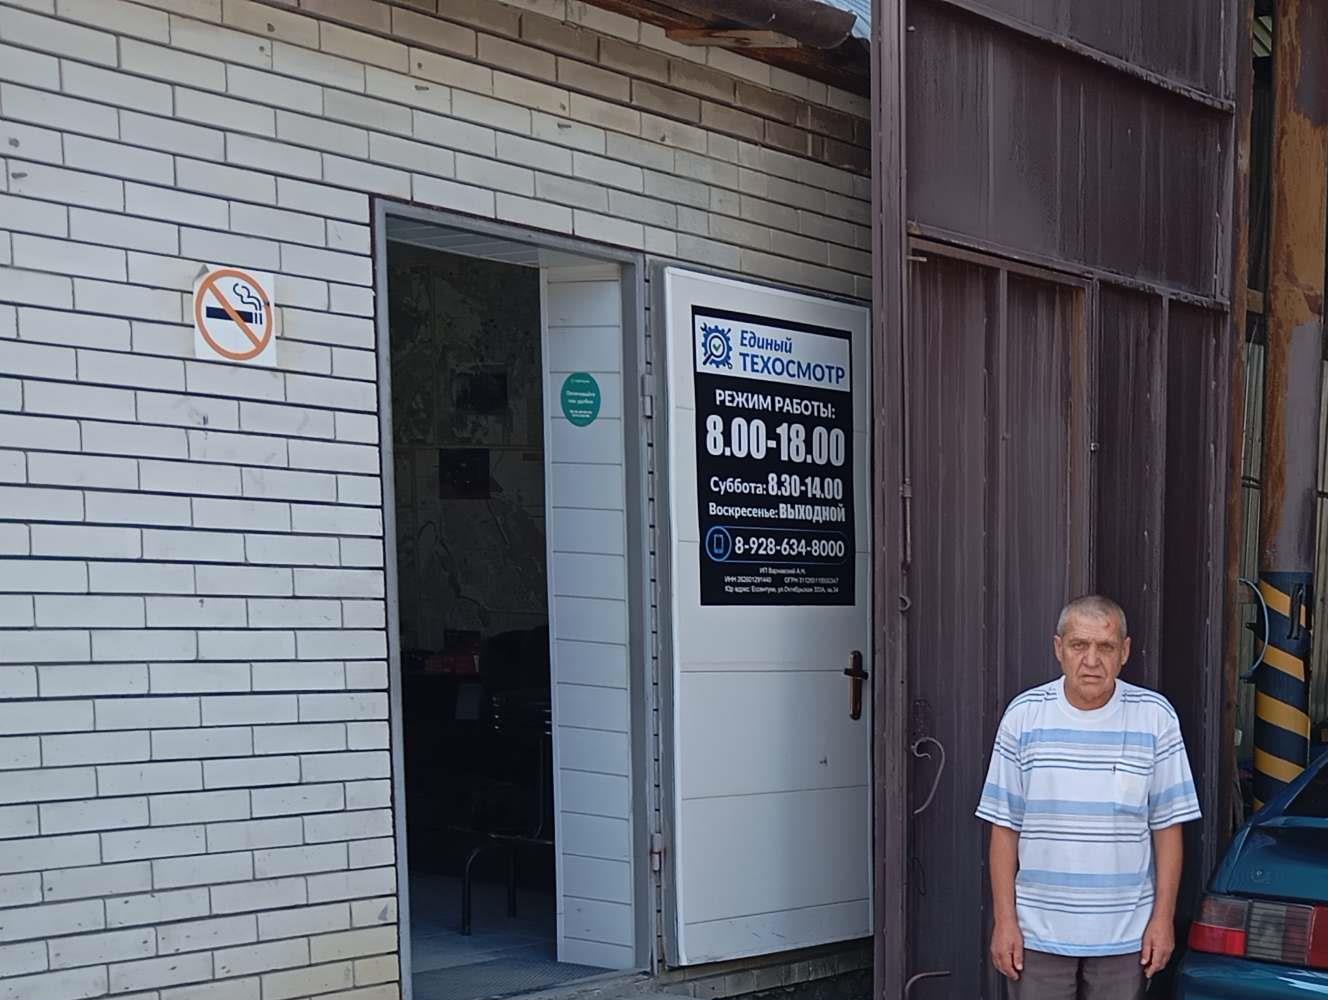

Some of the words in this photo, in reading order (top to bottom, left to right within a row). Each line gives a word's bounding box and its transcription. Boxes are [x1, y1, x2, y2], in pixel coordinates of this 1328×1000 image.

[739, 330, 793, 354] Единый
[739, 352, 846, 385] ТЕХОСМОТР
[715, 388, 772, 411] РЕЖИМ
[774, 396, 836, 419] РАБОТЫ:
[705, 414, 846, 467] 8.00-18.00
[710, 476, 767, 495] Суббота:
[767, 472, 843, 500] 8.30-14.00
[708, 501, 778, 519] Воскресенье:
[778, 502, 846, 524] ВЫХОДНОЙ
[734, 536, 845, 558] 8-928-634-8000
